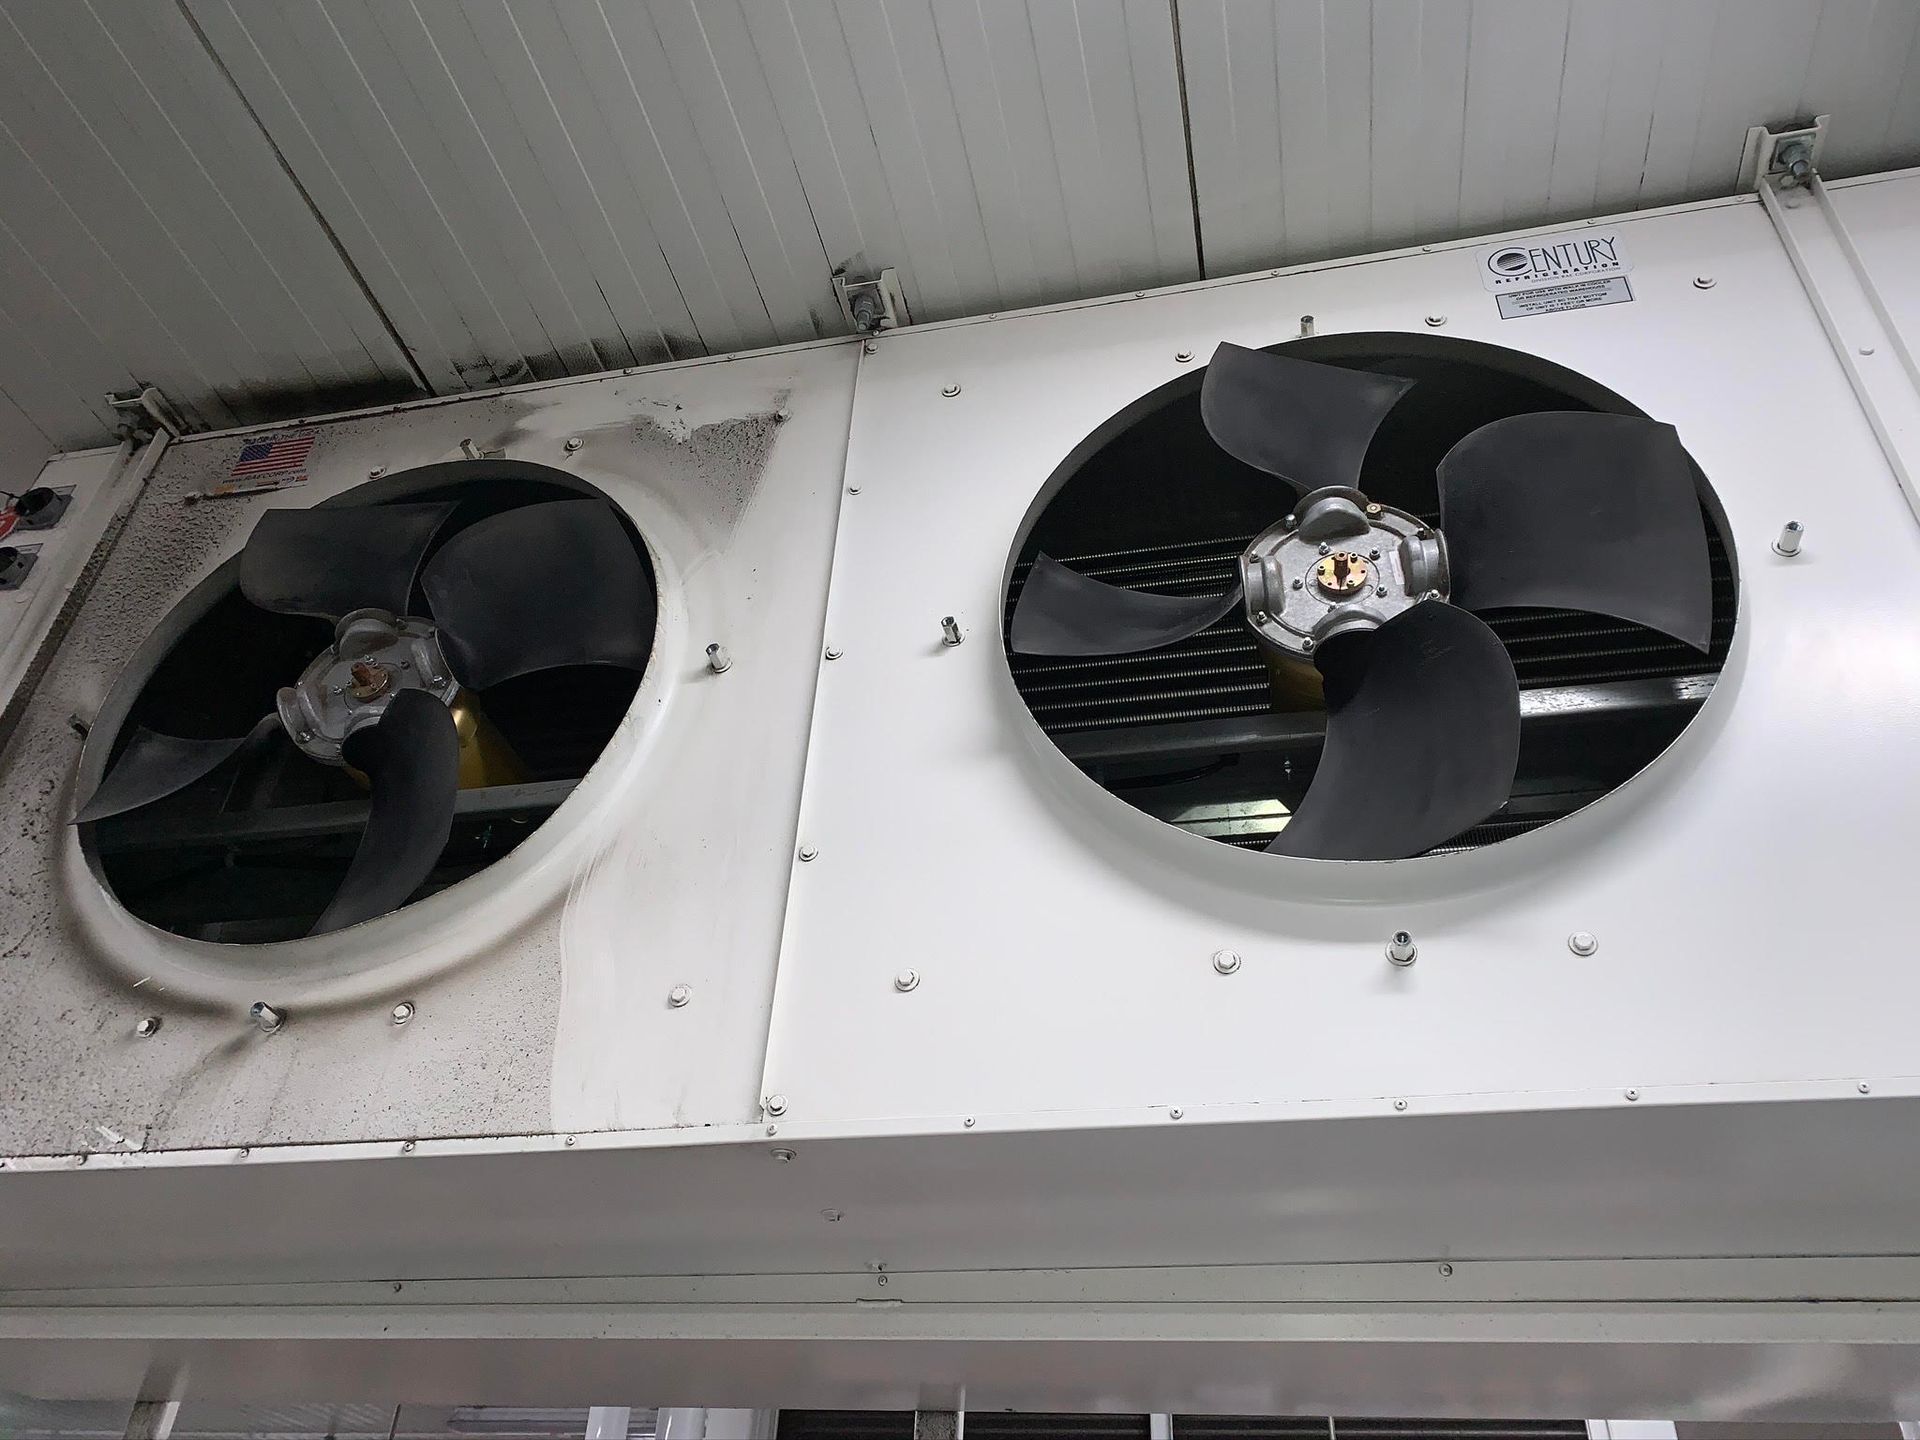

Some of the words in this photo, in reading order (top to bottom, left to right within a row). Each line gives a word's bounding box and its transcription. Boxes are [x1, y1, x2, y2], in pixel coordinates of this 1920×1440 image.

[1488, 237, 1617, 277] CENTURY
[1495, 262, 1619, 284] REFRIGERATION
[1525, 289, 1568, 299] REFRIGERATED
